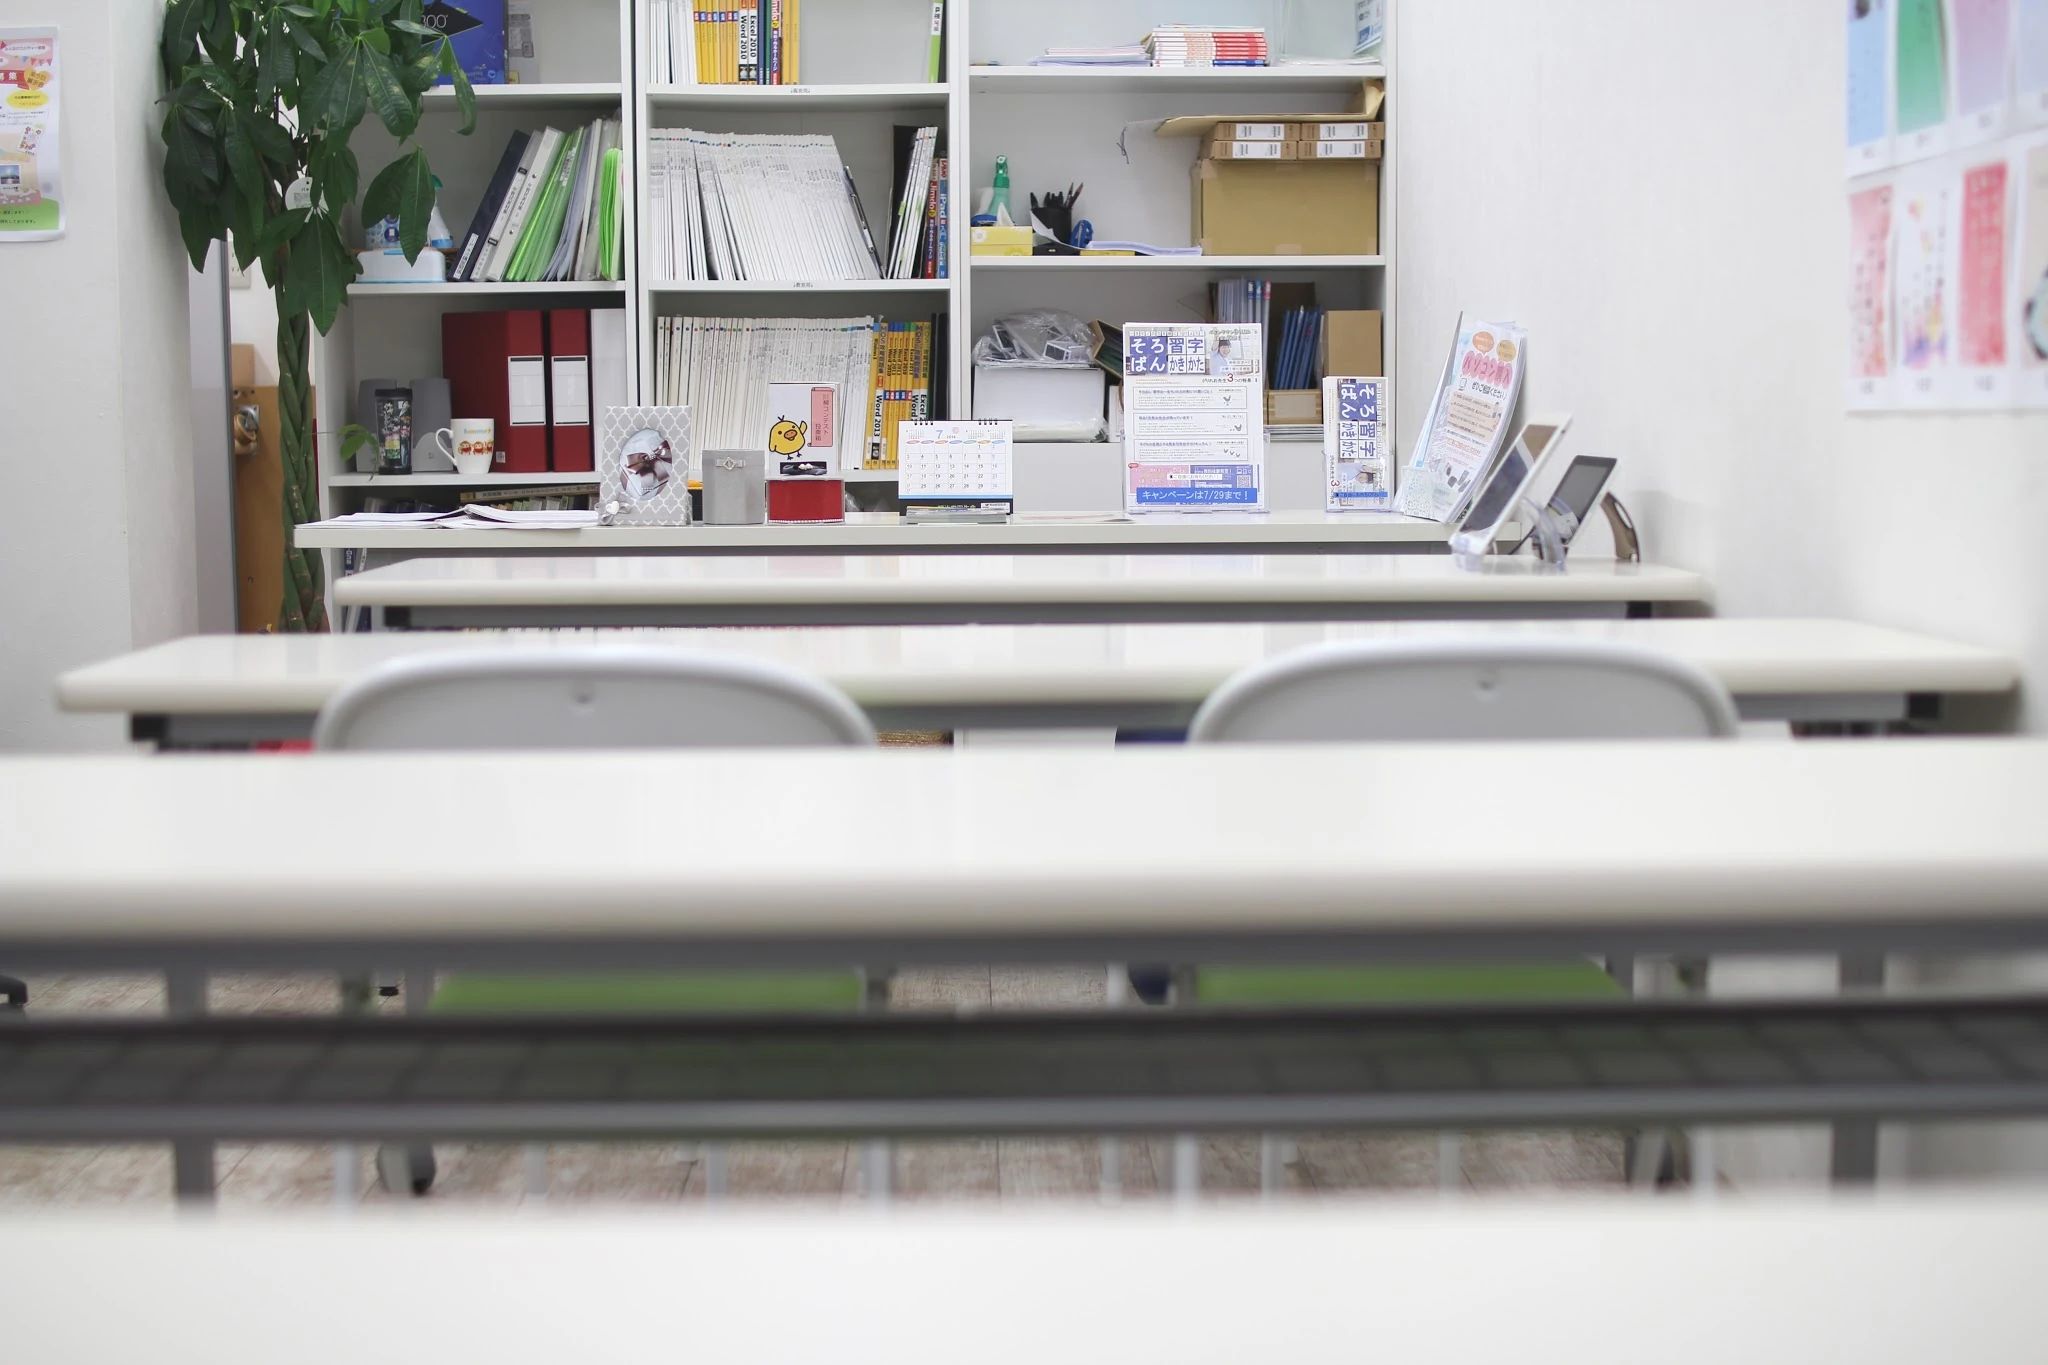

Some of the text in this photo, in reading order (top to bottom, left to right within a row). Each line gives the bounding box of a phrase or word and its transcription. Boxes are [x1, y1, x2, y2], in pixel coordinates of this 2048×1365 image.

[929, 182, 937, 209] Jimdo
[911, 395, 919, 417] Word
[873, 419, 881, 437] 2013
[936, 430, 943, 439] 7
